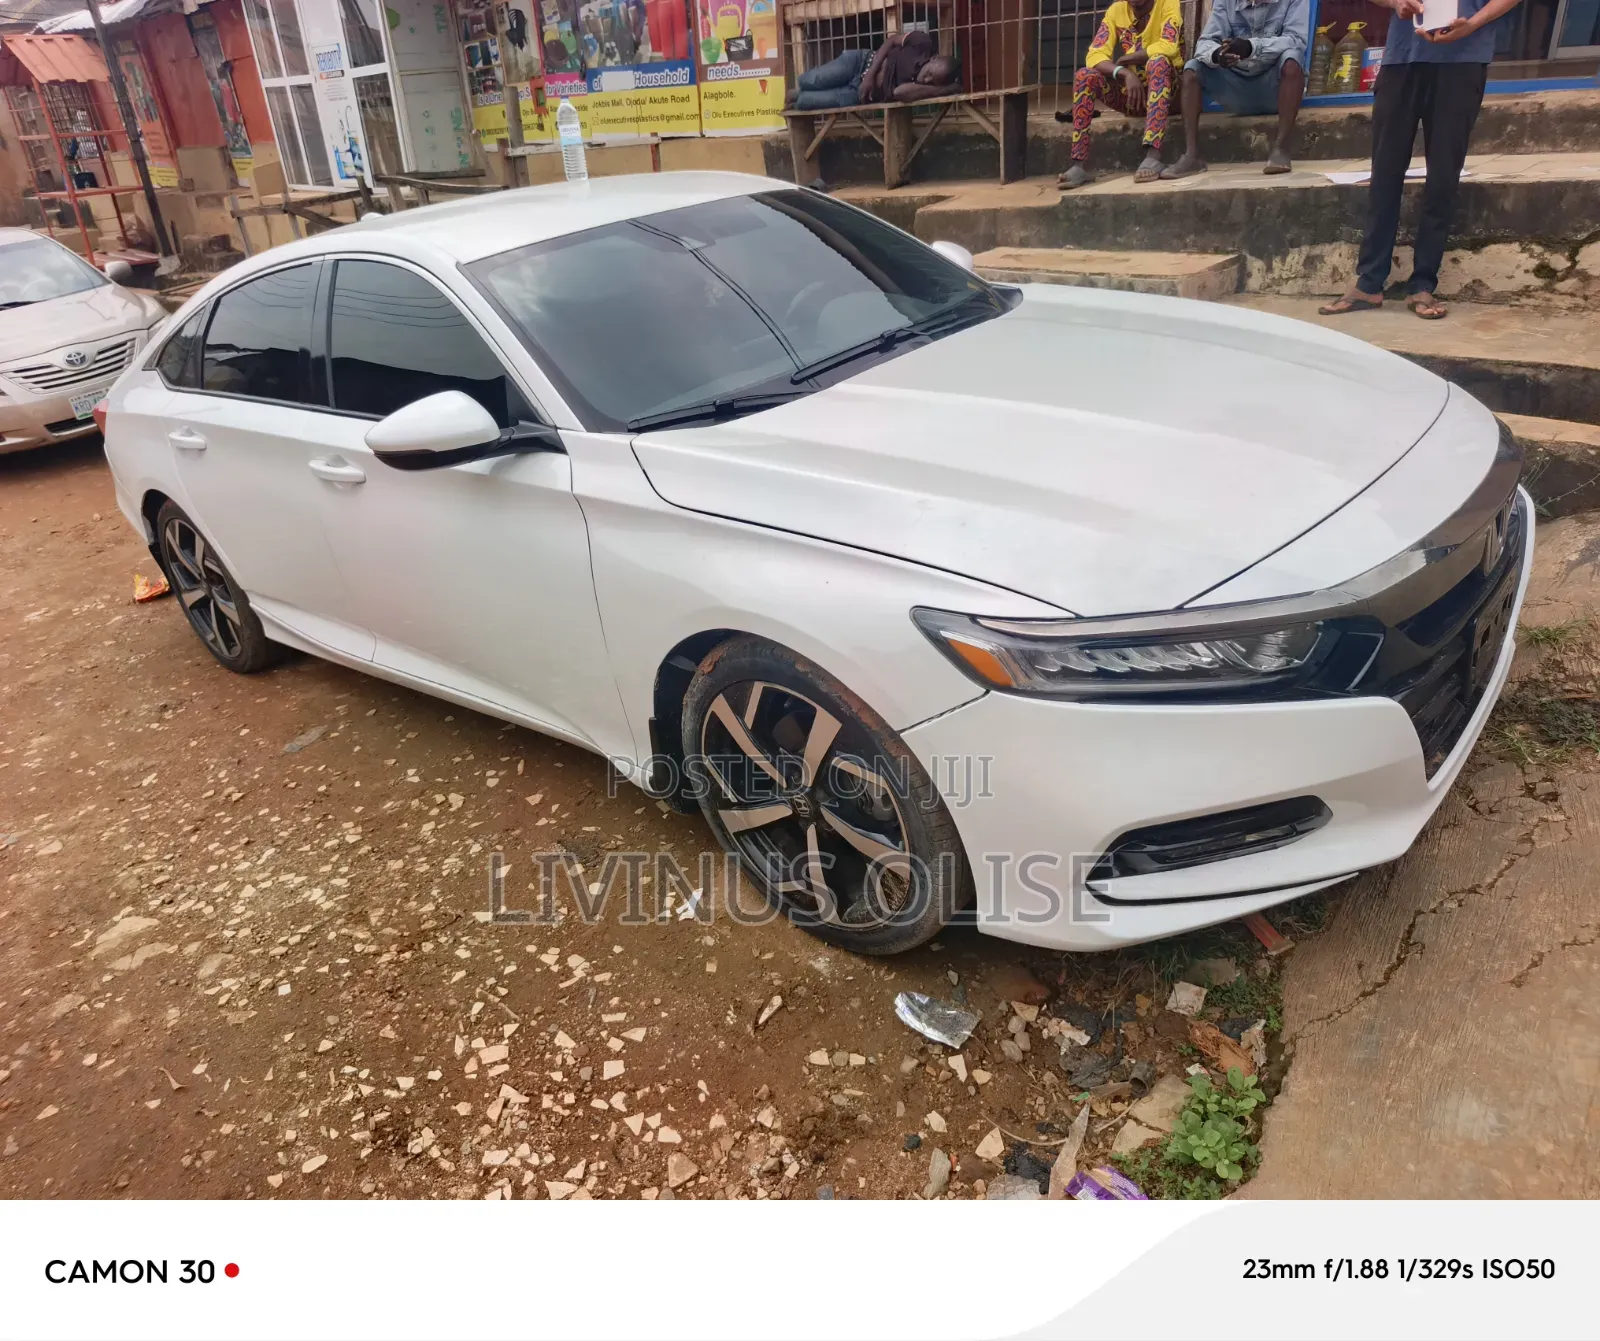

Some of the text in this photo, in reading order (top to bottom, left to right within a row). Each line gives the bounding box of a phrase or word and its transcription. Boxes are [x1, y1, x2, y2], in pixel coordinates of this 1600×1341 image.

[634, 68, 690, 87] Household
[556, 80, 588, 95] Varieties
[649, 96, 668, 104] Akute
[671, 94, 690, 103] Road
